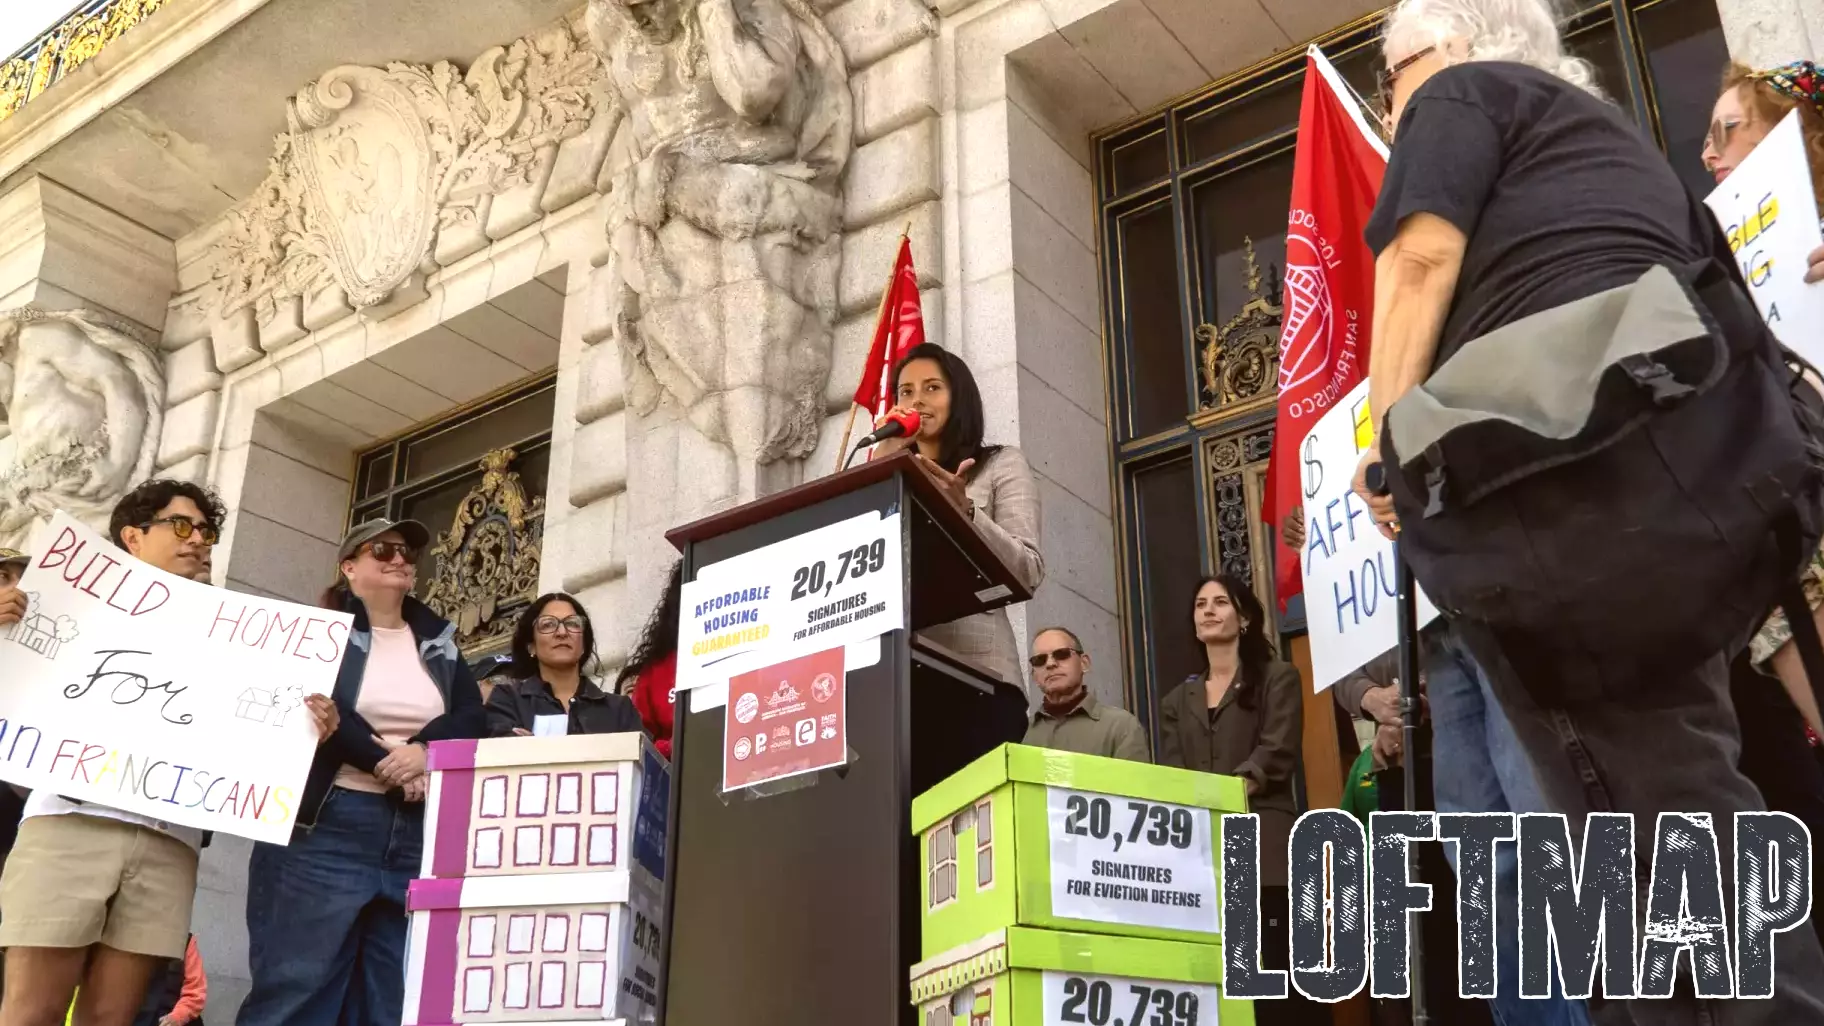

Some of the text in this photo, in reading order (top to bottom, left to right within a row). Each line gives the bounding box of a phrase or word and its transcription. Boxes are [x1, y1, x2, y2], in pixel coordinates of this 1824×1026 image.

[1307, 488, 1377, 577] AFF
[790, 537, 886, 602] 20,739
[38, 526, 348, 664] BUILD HOMES
[694, 585, 771, 619] AFFORDABLE
[807, 591, 868, 624] SIGNATURES
[692, 624, 770, 657] GUARANTEED
[704, 608, 759, 635] HOUSING
[793, 601, 886, 641] FOR AFFORDABLE HOUSING
[63, 650, 194, 726] For
[49, 739, 295, 826] FRANCISCANS
[1064, 795, 1193, 853] 20,739
[1091, 859, 1173, 884] SIGNATURES
[1067, 879, 1202, 908] FOR EVICTION DEFENSE
